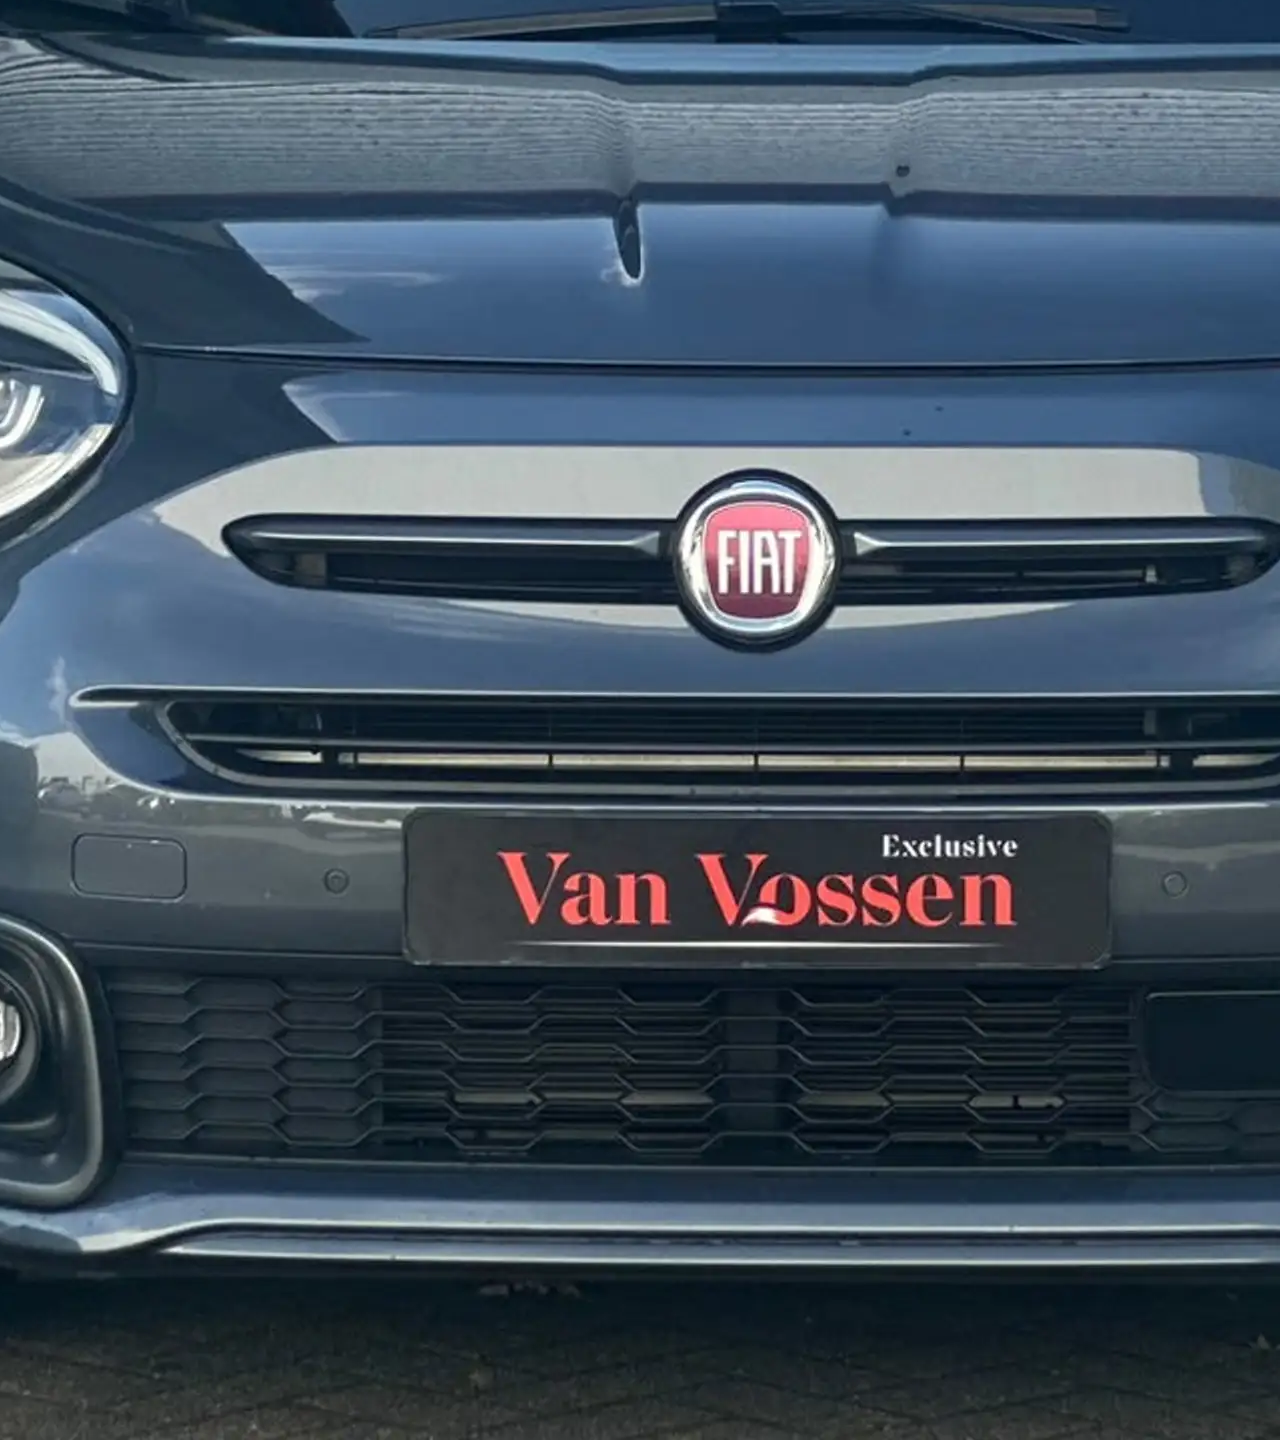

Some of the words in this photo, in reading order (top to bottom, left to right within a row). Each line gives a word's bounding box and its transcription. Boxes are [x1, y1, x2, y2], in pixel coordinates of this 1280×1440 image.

[716, 529, 803, 595] FIAT
[880, 833, 1019, 859] Exclusive
[497, 851, 672, 926] Van
[696, 853, 1017, 928] Vossen
